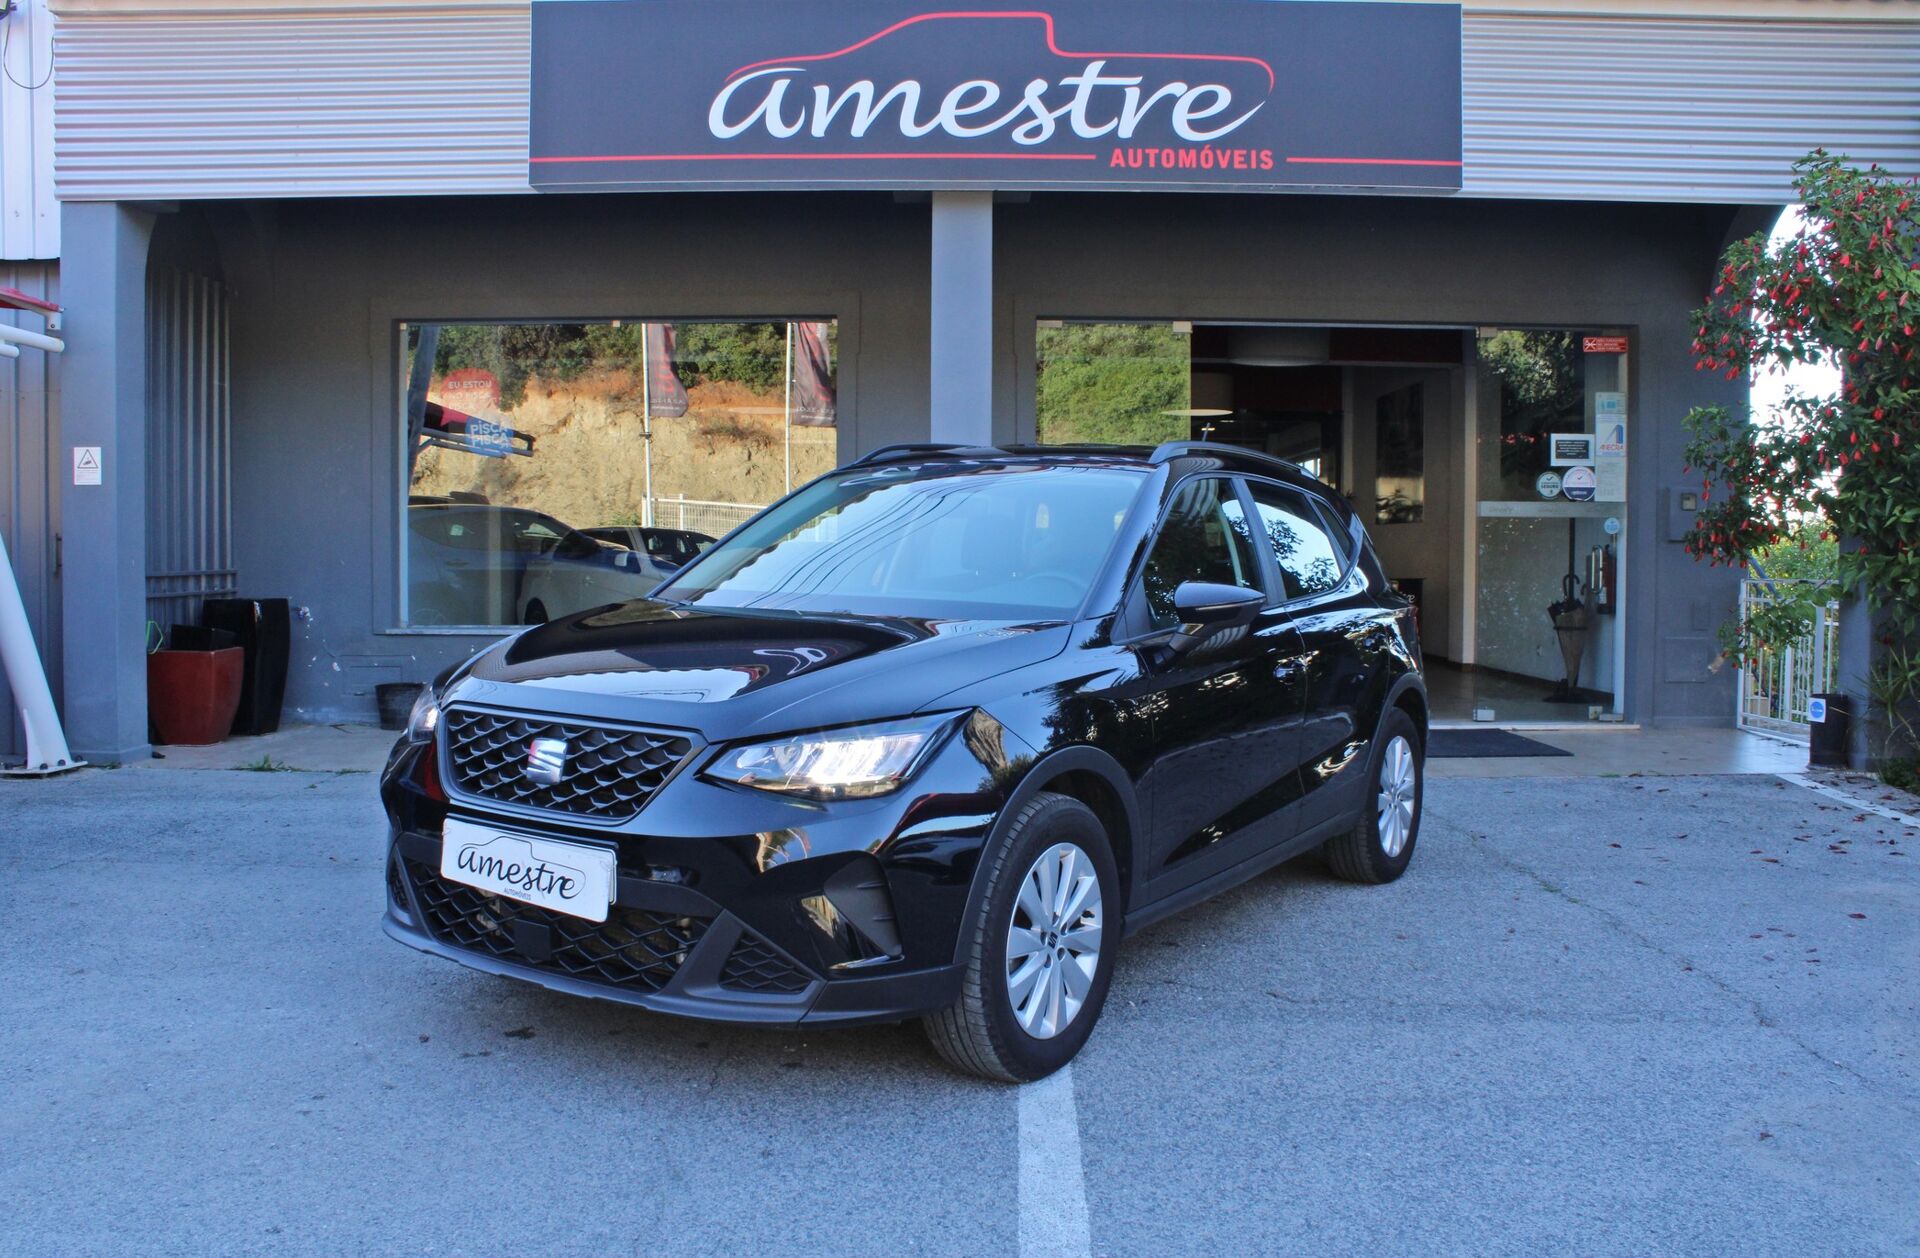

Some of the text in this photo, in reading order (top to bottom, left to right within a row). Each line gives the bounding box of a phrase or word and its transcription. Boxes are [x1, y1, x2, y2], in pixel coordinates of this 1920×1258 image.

[708, 61, 1265, 145] amestre
[1109, 145, 1274, 170] AUTOMÓVEIS
[458, 846, 581, 899] amestre
